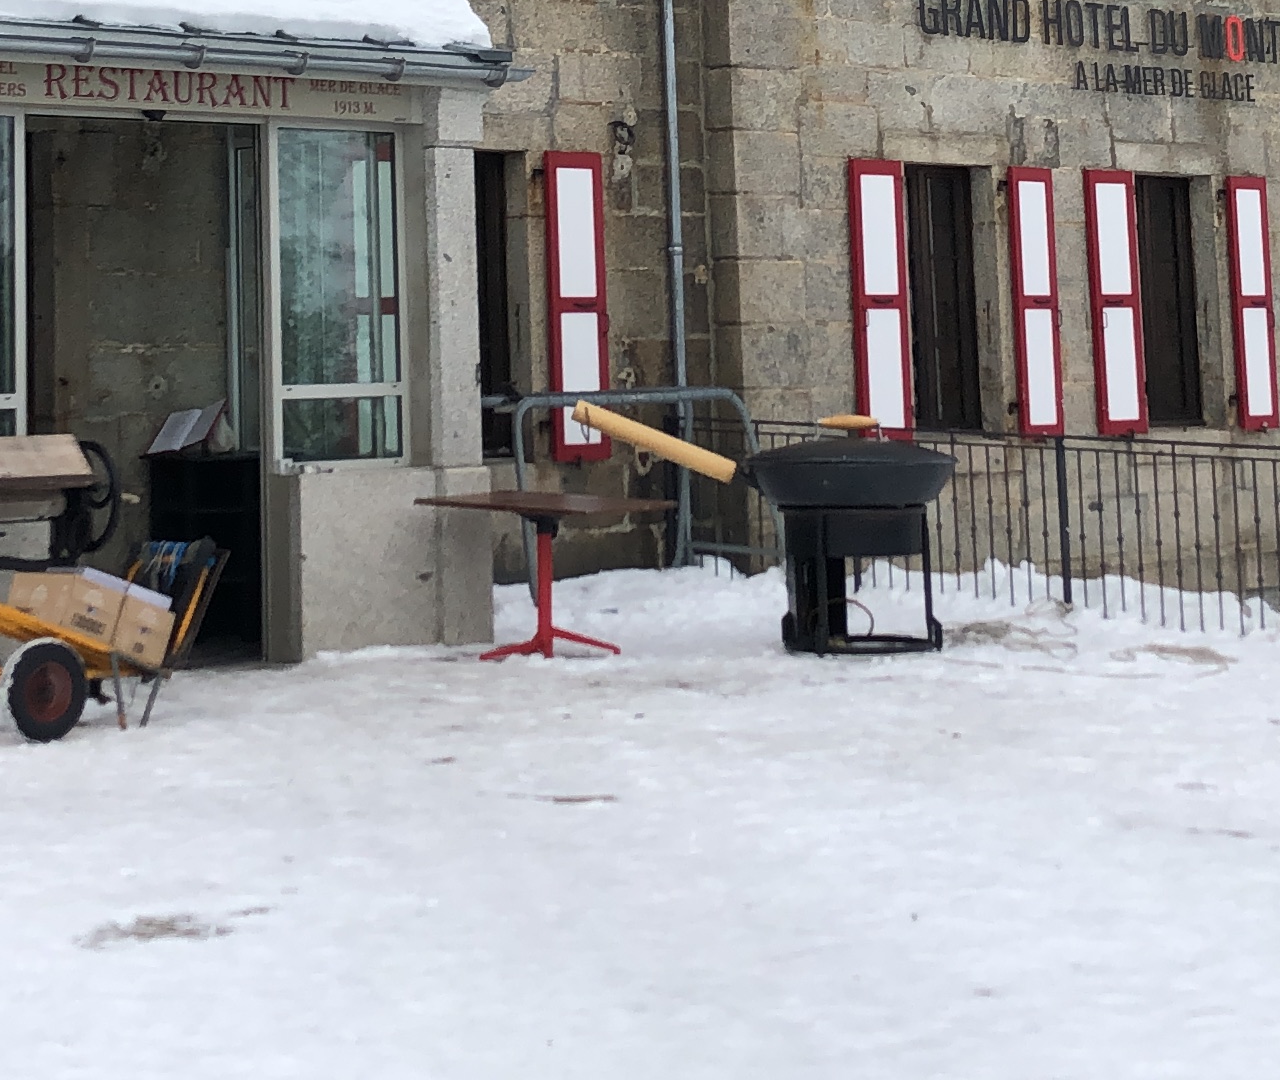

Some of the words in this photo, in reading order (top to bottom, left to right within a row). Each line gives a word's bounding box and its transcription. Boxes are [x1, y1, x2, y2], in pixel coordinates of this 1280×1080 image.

[1148, 8, 1189, 56] DU
[43, 63, 296, 111] RESTAURANT
[339, 81, 357, 94] DE
[1073, 60, 1089, 91] A
[1093, 61, 1119, 92] LA
[1122, 64, 1166, 97] MER
[1170, 68, 1195, 99] DE
[1200, 70, 1256, 103] GLACE
[334, 100, 361, 116] 1913
